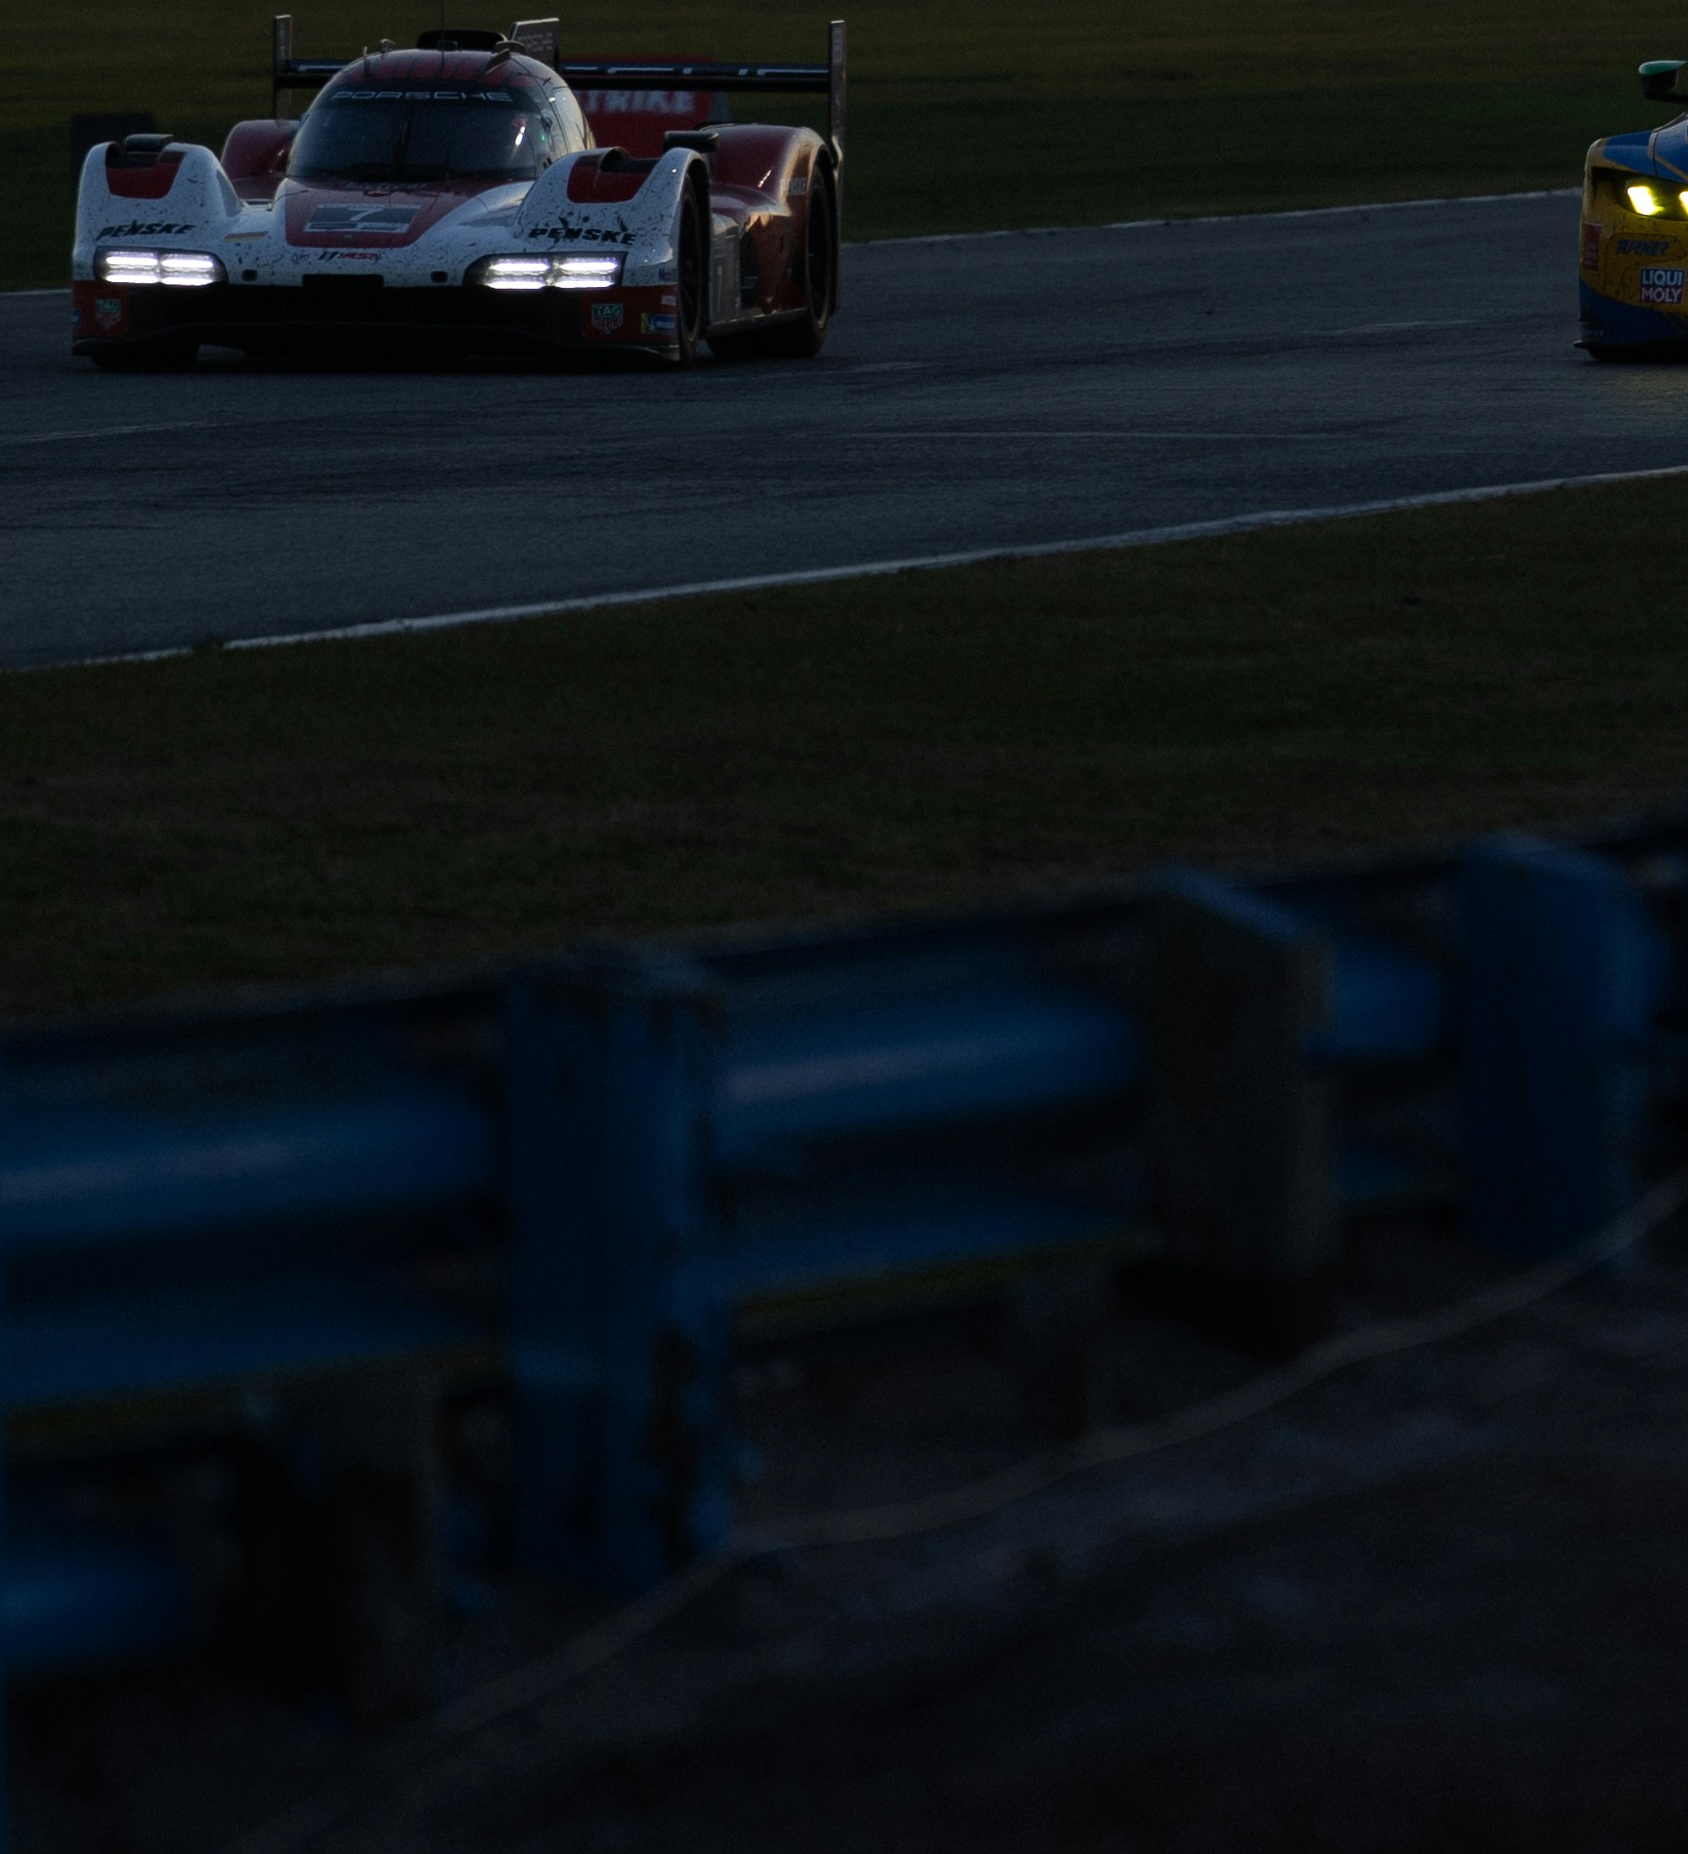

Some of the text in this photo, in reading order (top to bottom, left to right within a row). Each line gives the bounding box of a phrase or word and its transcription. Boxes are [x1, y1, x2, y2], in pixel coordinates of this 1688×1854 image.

[331, 91, 514, 103] PORSCHE
[348, 207, 384, 222] 7
[96, 223, 196, 241] PENSKE
[529, 228, 637, 245] PENSKE
[1616, 239, 1669, 256] TURNER
[1642, 270, 1683, 285] LIQUI
[1641, 287, 1682, 303] MOLY
[596, 306, 621, 316] TAG
